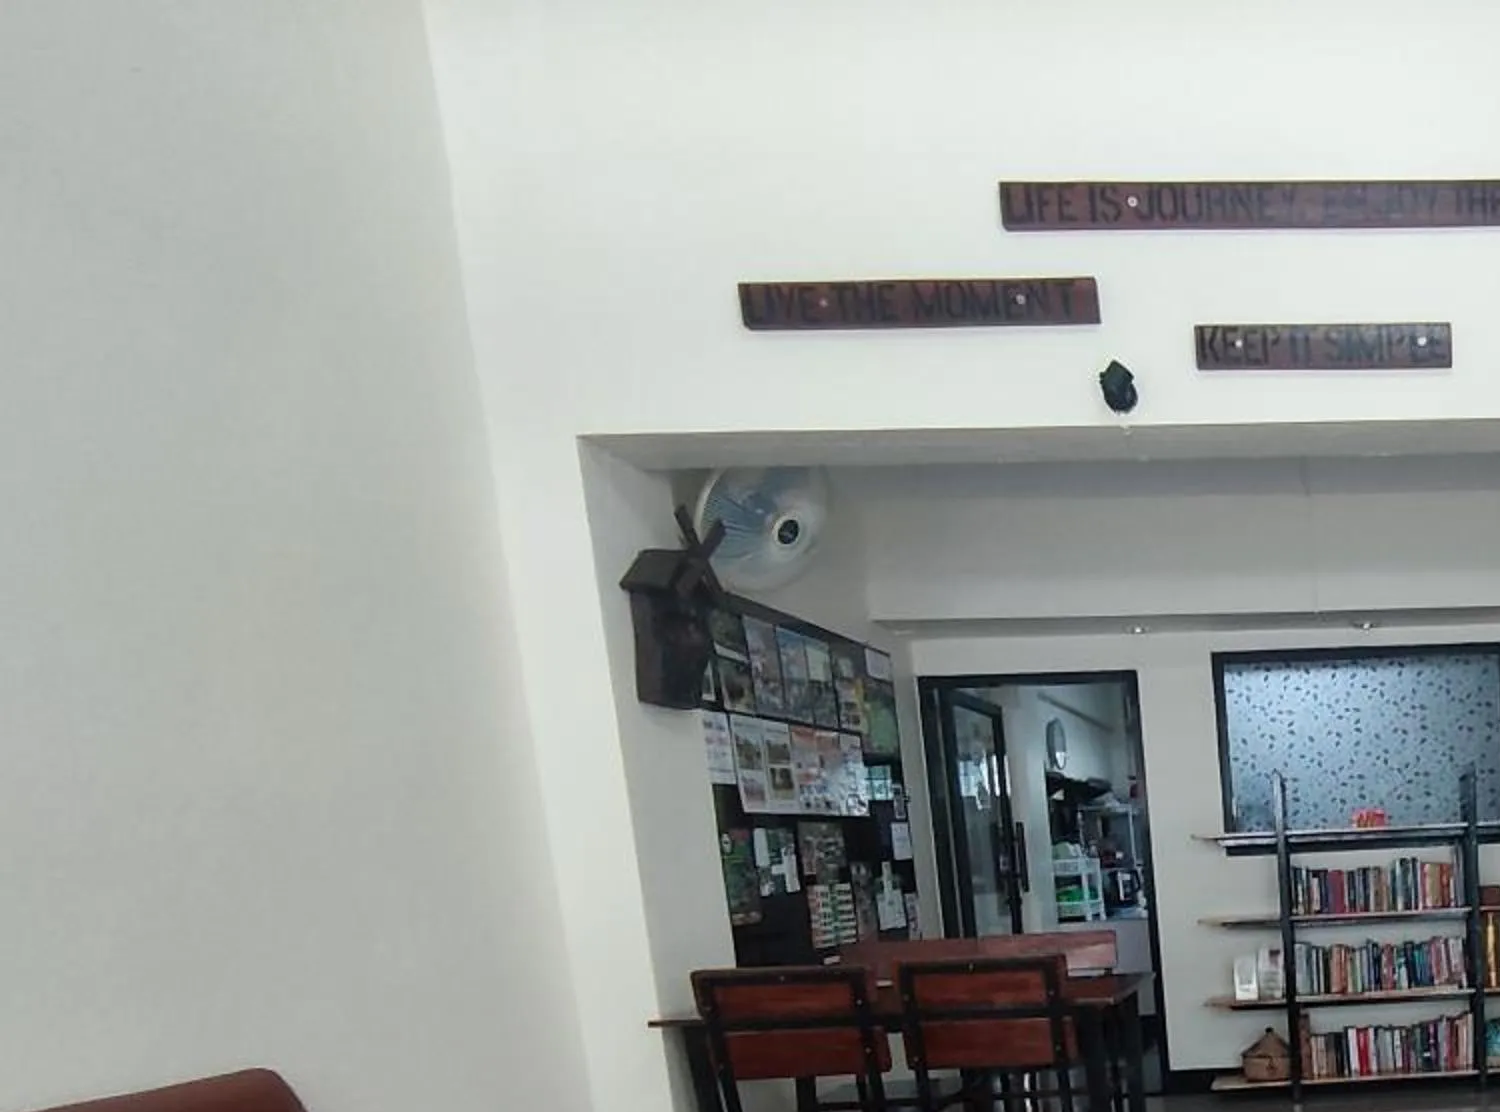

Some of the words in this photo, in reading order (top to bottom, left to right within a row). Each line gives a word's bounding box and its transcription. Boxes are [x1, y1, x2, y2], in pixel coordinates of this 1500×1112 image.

[1005, 184, 1078, 224] LIFE
[1088, 184, 1125, 223] IS
[747, 283, 820, 325] LIVE
[828, 283, 900, 323] THE
[911, 280, 1076, 320] MOMENT
[1199, 326, 1281, 366] KEEP
